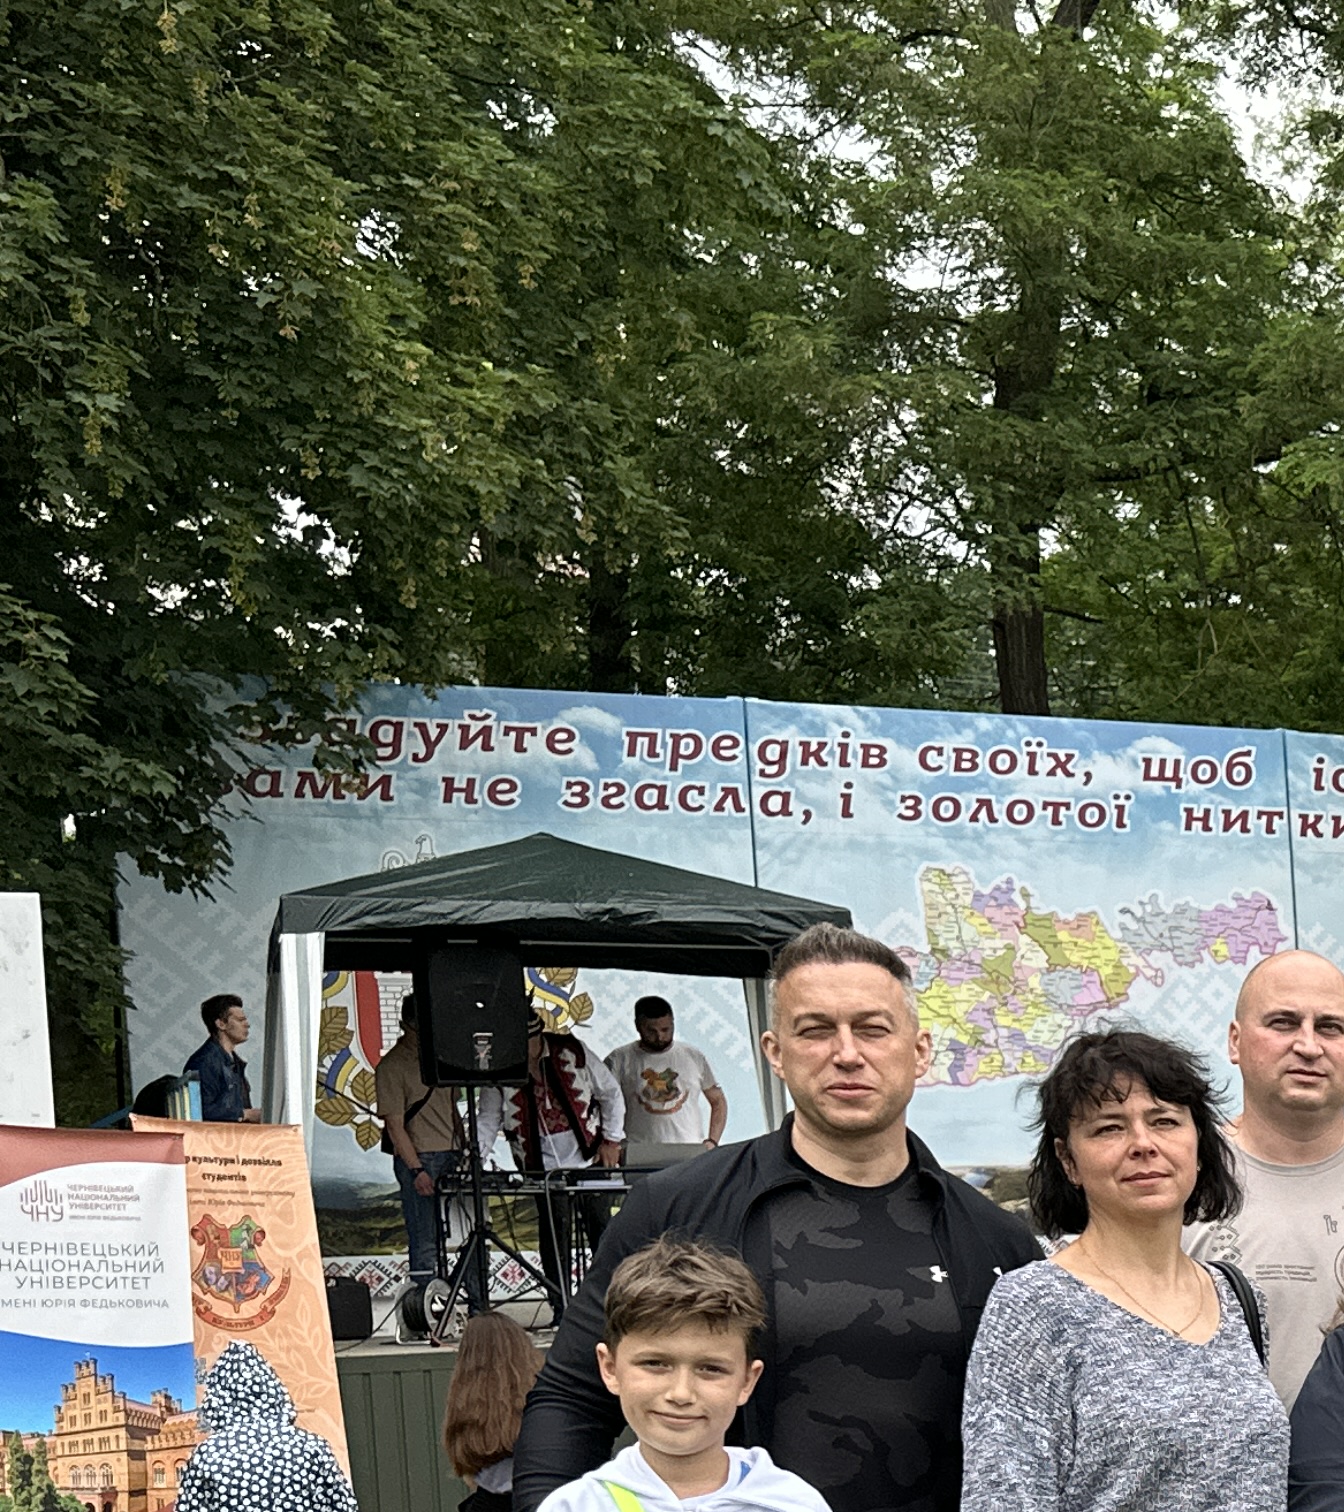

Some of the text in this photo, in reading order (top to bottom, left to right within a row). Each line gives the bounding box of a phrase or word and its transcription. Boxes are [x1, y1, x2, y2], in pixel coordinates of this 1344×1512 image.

[625, 729, 888, 779] предків
[918, 740, 1094, 787] своїх,
[1142, 749, 1254, 789] щоб
[441, 775, 519, 806] не
[562, 779, 813, 825] згасла,
[839, 781, 854, 819] і
[898, 792, 1132, 830] золотої
[20, 1204, 64, 1222] ЧНУ
[1, 1241, 160, 1258] ЧЕРНІВЕЦЬКИЙ
[0, 1257, 165, 1275] НАЦІОНАЛЬНИЙ
[15, 1275, 152, 1290] УНІВЕРСИТЕТ
[0, 1298, 170, 1309] МЕНІ ЮРІЯ ФЕДЬКОВИЧА
